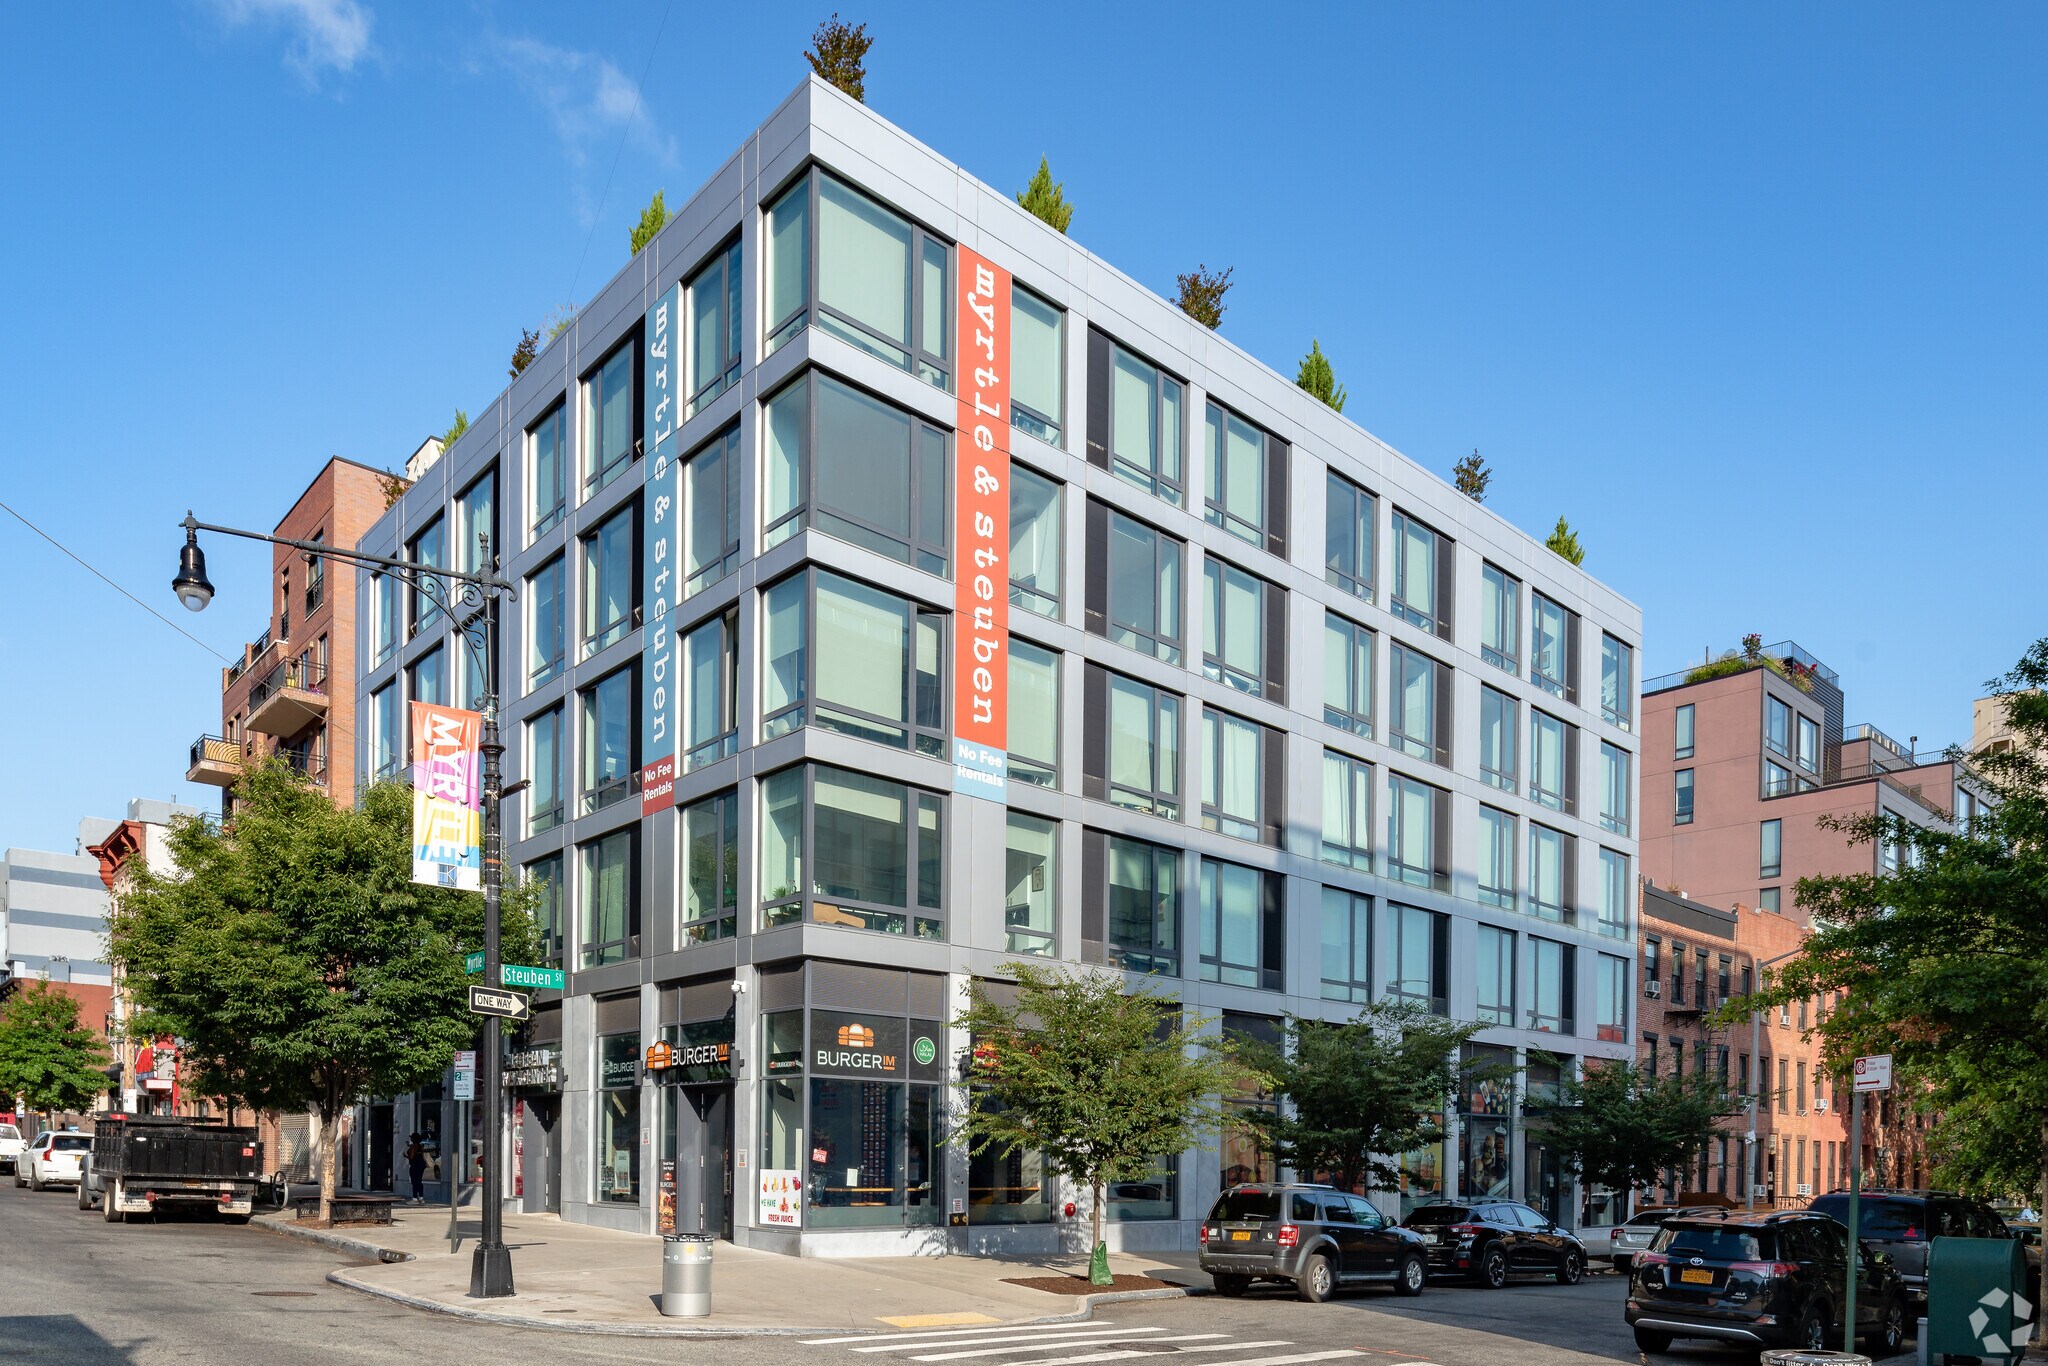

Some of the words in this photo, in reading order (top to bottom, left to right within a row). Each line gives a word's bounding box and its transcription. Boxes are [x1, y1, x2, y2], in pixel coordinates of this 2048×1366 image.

[967, 262, 1001, 453] myrtle
[651, 300, 671, 482] myrtle
[973, 463, 1000, 496] &
[654, 494, 671, 524] &
[972, 510, 1000, 725] steuben
[652, 537, 671, 744] steuben
[958, 743, 977, 762] No
[979, 750, 1003, 769] Fee
[644, 767, 656, 784] No
[657, 761, 673, 778] Fee
[956, 763, 1005, 788] Rentals
[643, 780, 673, 803] Rentals
[467, 954, 482, 973] Myrtle
[505, 967, 551, 986] Steuben
[555, 972, 563, 982] St
[477, 994, 494, 1007] ONE
[496, 997, 512, 1009] WAY
[613, 1062, 635, 1073] BURGE
[768, 1213, 780, 1223] FRESH
[780, 1215, 794, 1223] JUICE
[1769, 1357, 1785, 1366] Don't
